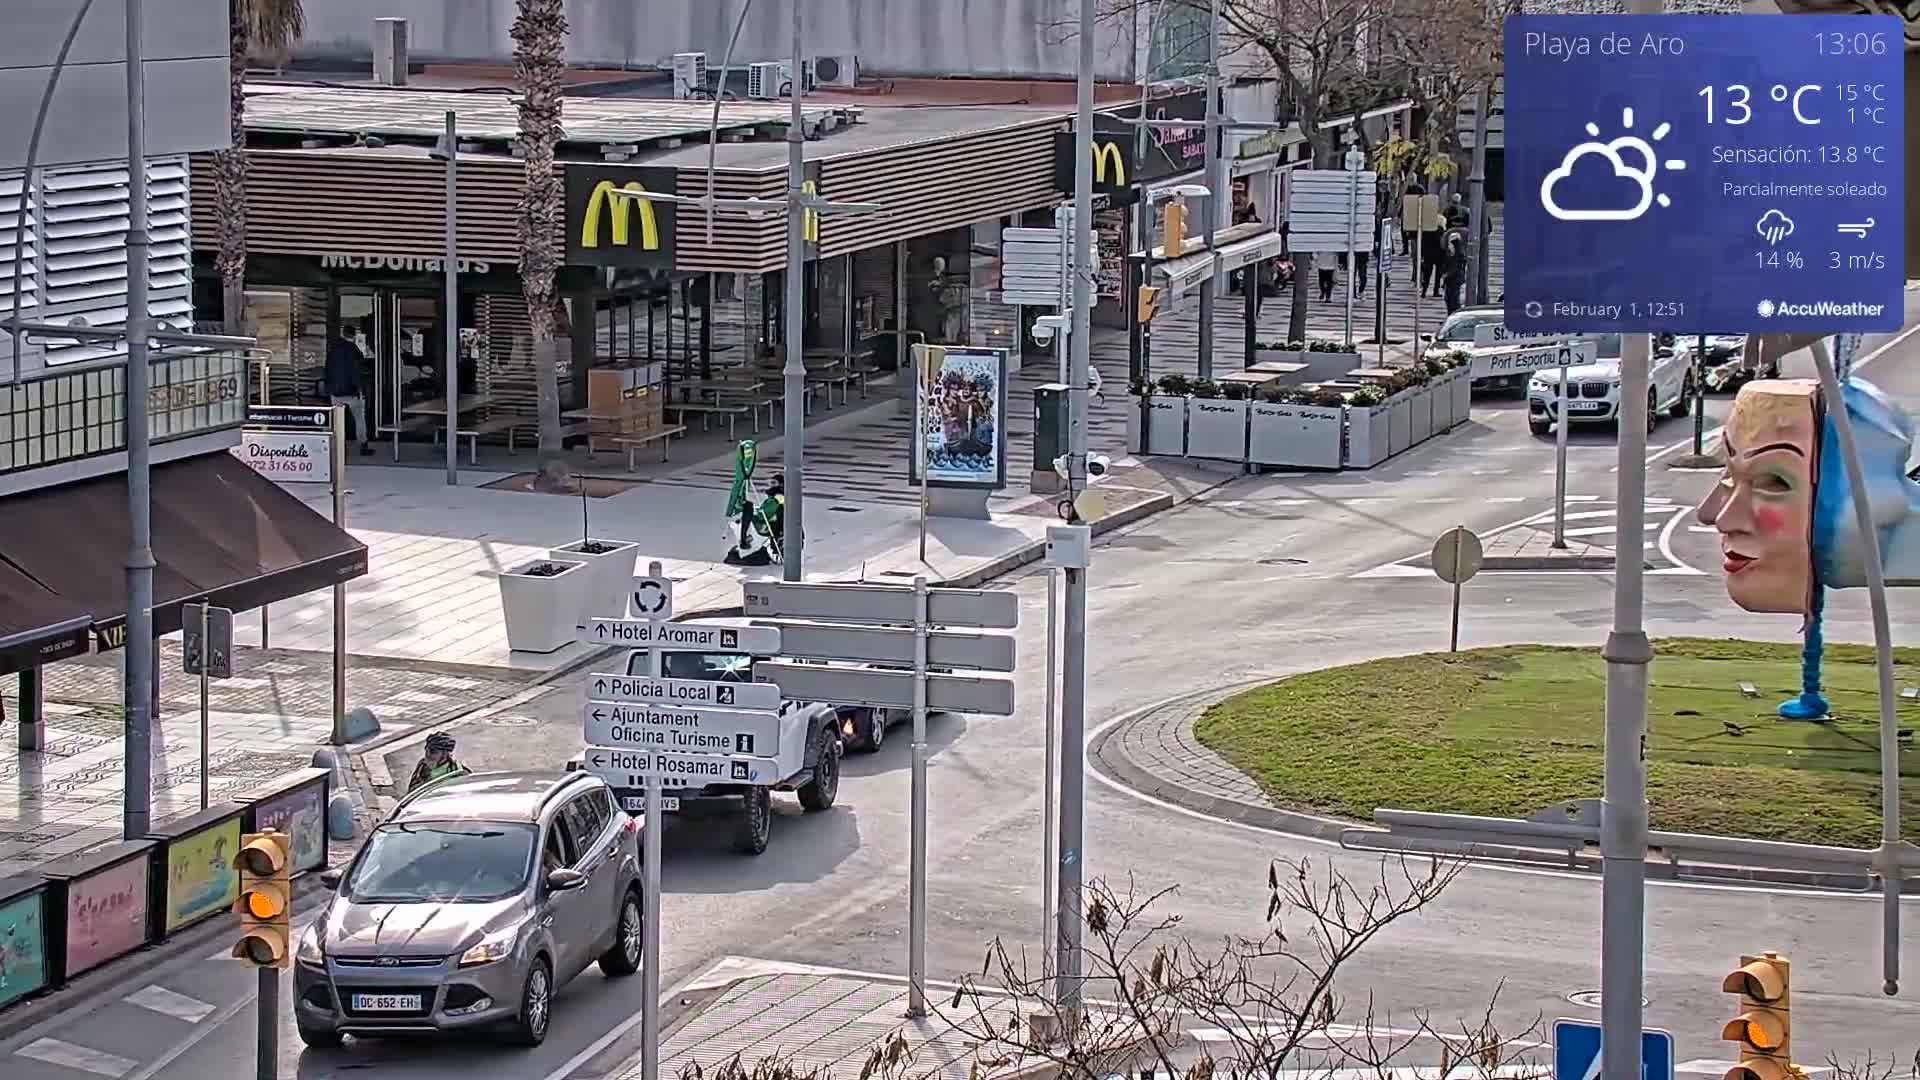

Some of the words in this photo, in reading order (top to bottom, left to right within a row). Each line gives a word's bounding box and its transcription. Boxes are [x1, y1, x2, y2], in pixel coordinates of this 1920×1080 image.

[1494, 327, 1508, 341] St.
[1491, 356, 1512, 370] Port
[1515, 352, 1556, 368] Esportiu
[248, 443, 309, 460] Disponible
[299, 461, 312, 472] 00
[612, 623, 652, 641] Hotel
[658, 626, 714, 643] Aromar
[612, 679, 663, 697] Policia
[669, 682, 710, 700] Local
[611, 707, 699, 727] Ajuntament
[611, 726, 664, 744] Oficina
[670, 730, 730, 748] Turisme
[611, 752, 651, 770] Hotel
[657, 756, 725, 775] Rosamar
